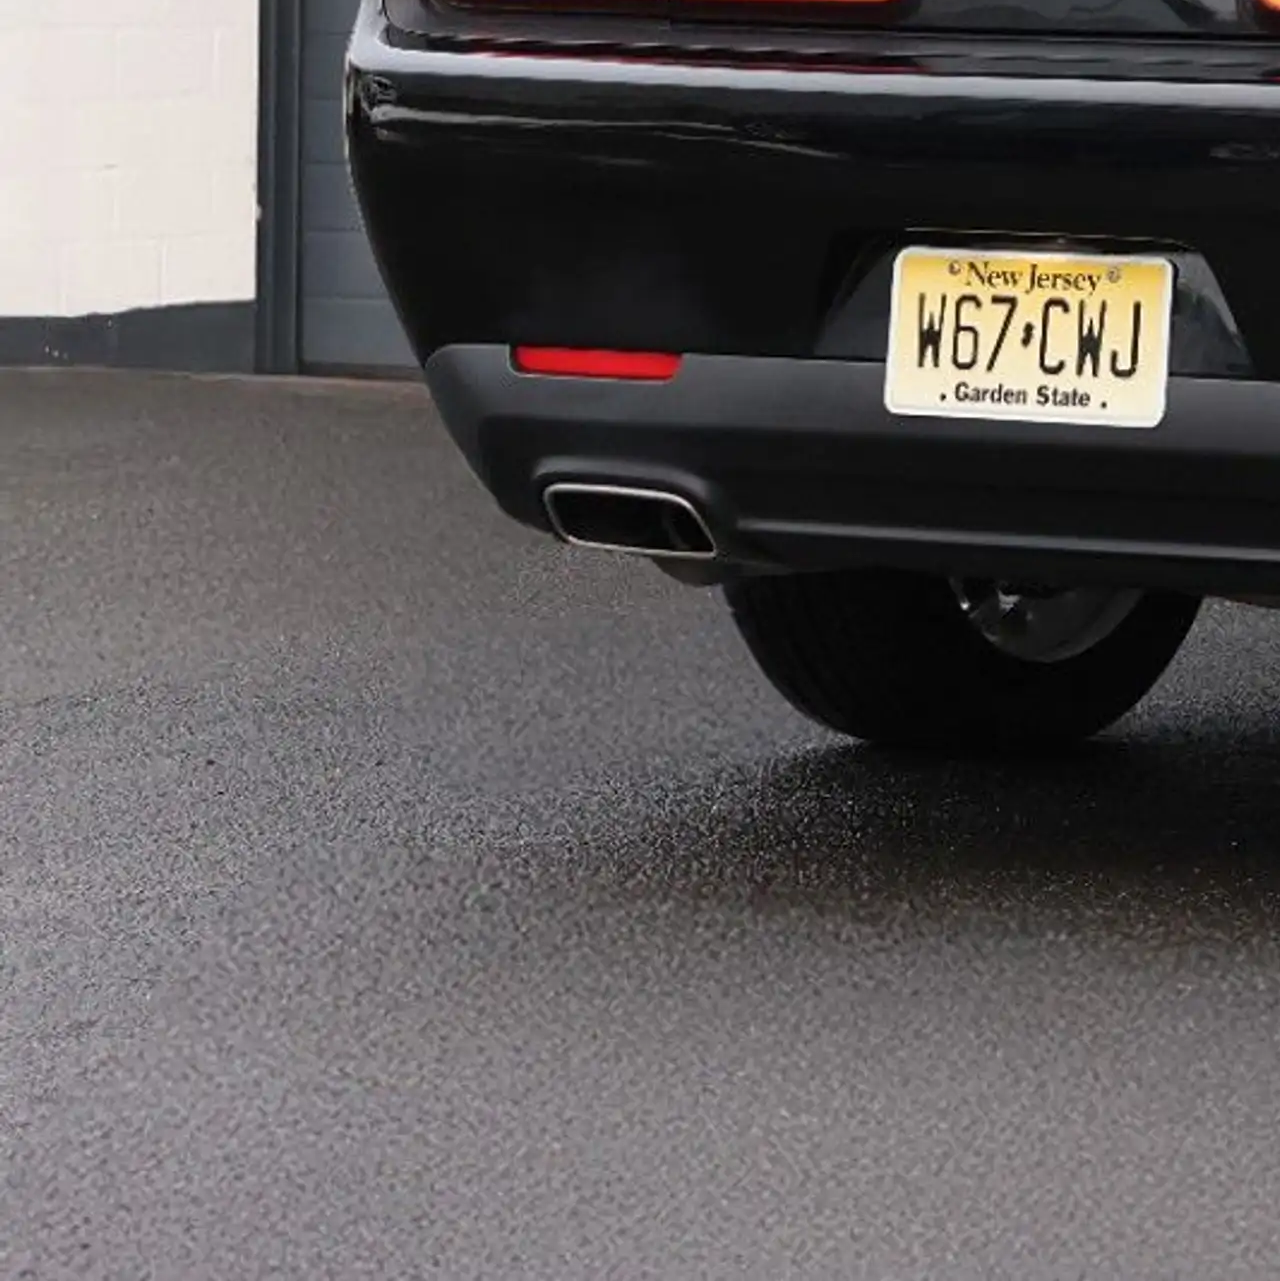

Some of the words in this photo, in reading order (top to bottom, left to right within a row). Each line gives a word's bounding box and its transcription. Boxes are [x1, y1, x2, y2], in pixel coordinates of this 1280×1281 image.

[966, 261, 1021, 287] New
[1024, 264, 1101, 294] Jersey
[954, 381, 1028, 405] Garden
[1036, 385, 1091, 408] State
